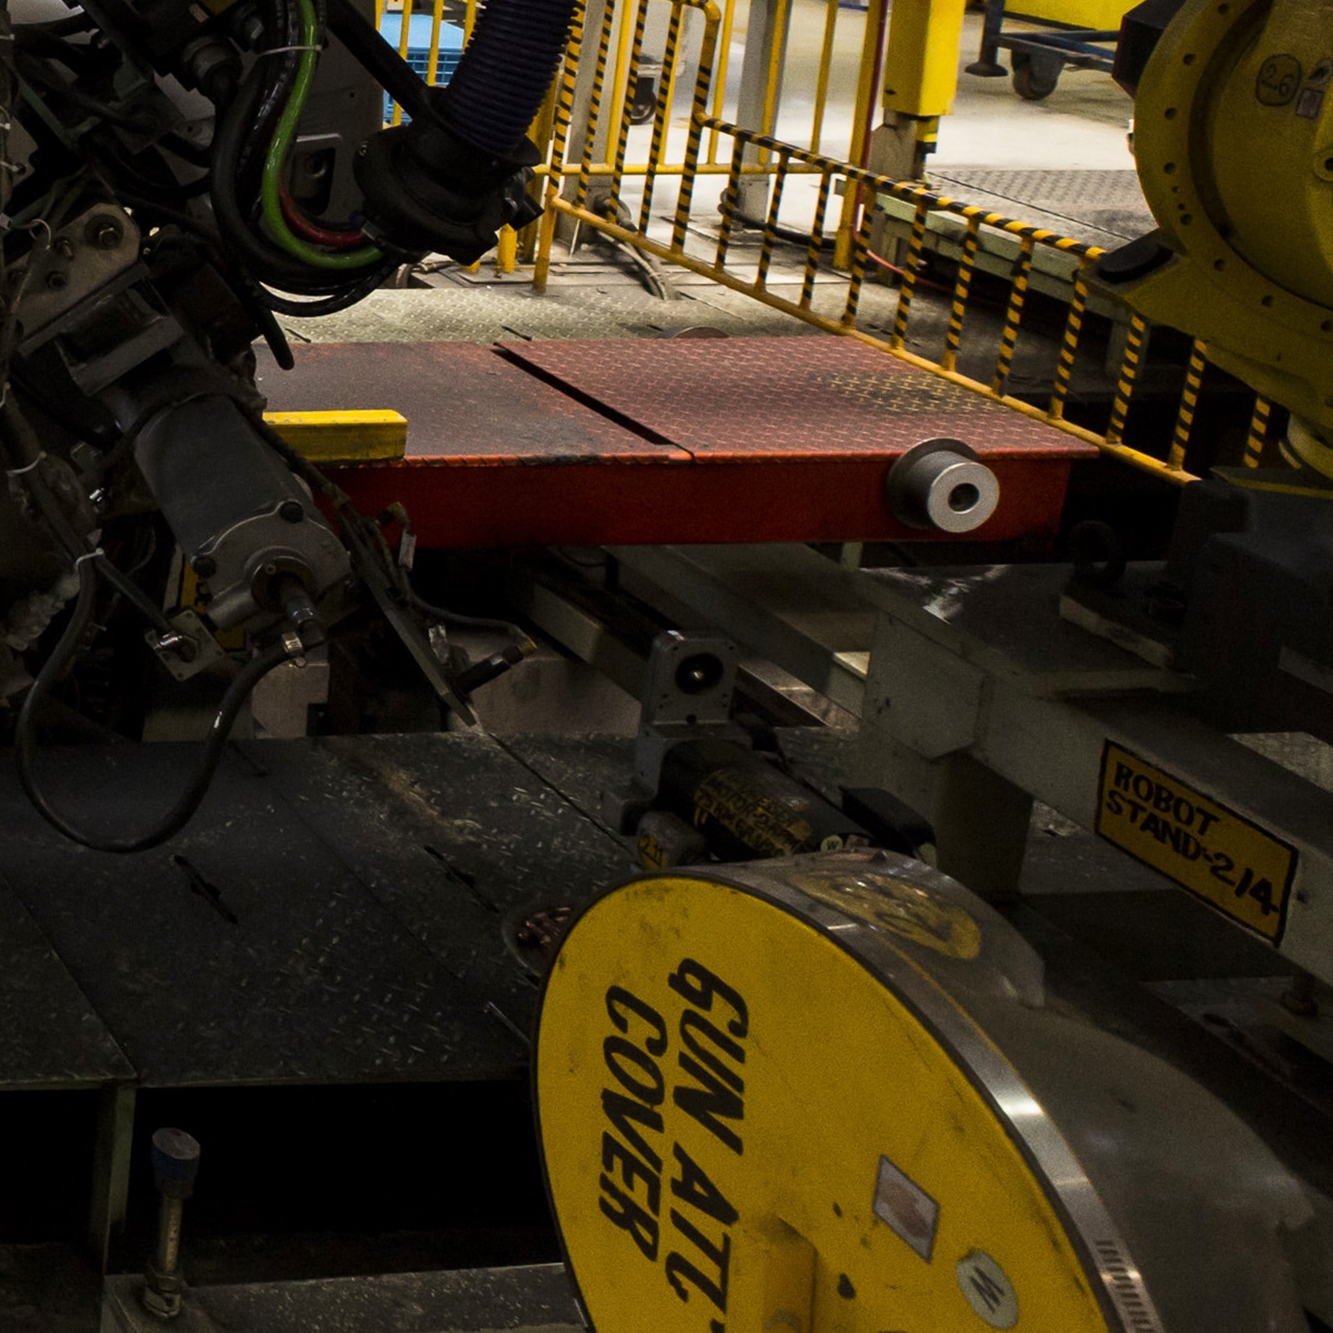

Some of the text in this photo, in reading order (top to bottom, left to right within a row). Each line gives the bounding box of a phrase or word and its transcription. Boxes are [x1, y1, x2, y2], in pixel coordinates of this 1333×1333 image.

[1114, 761, 1221, 836] ROBOT
[598, 984, 669, 1263] COVER
[665, 957, 749, 1317] GUN ATC
